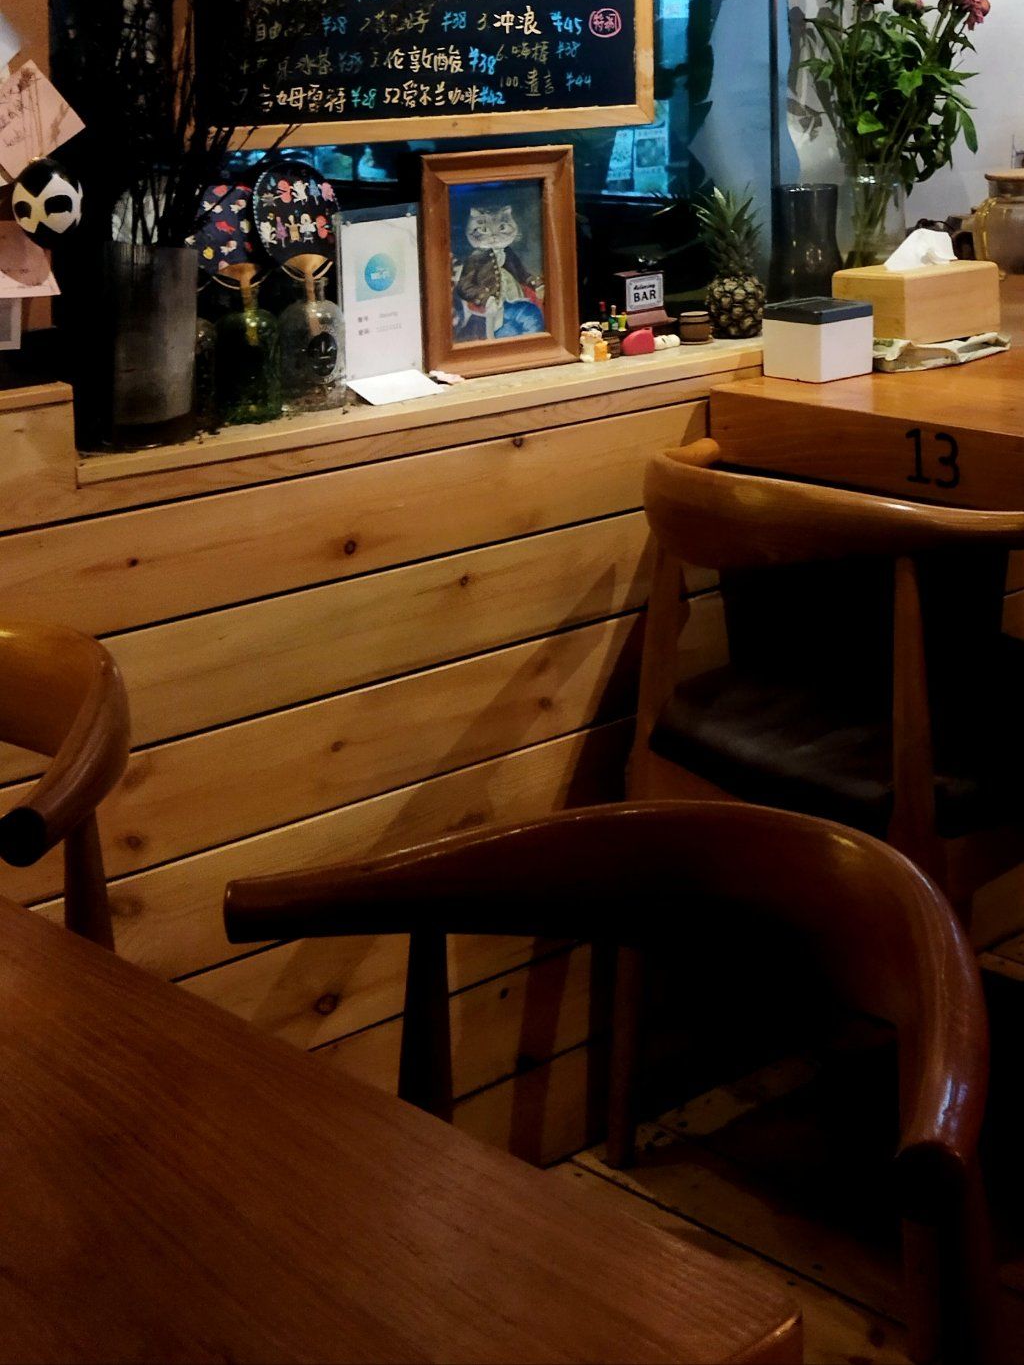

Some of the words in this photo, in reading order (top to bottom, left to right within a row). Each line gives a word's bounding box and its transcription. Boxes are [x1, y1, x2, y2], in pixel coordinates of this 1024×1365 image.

[549, 11, 583, 36] ¥45
[633, 289, 657, 303] BAR
[905, 427, 960, 489] 13
